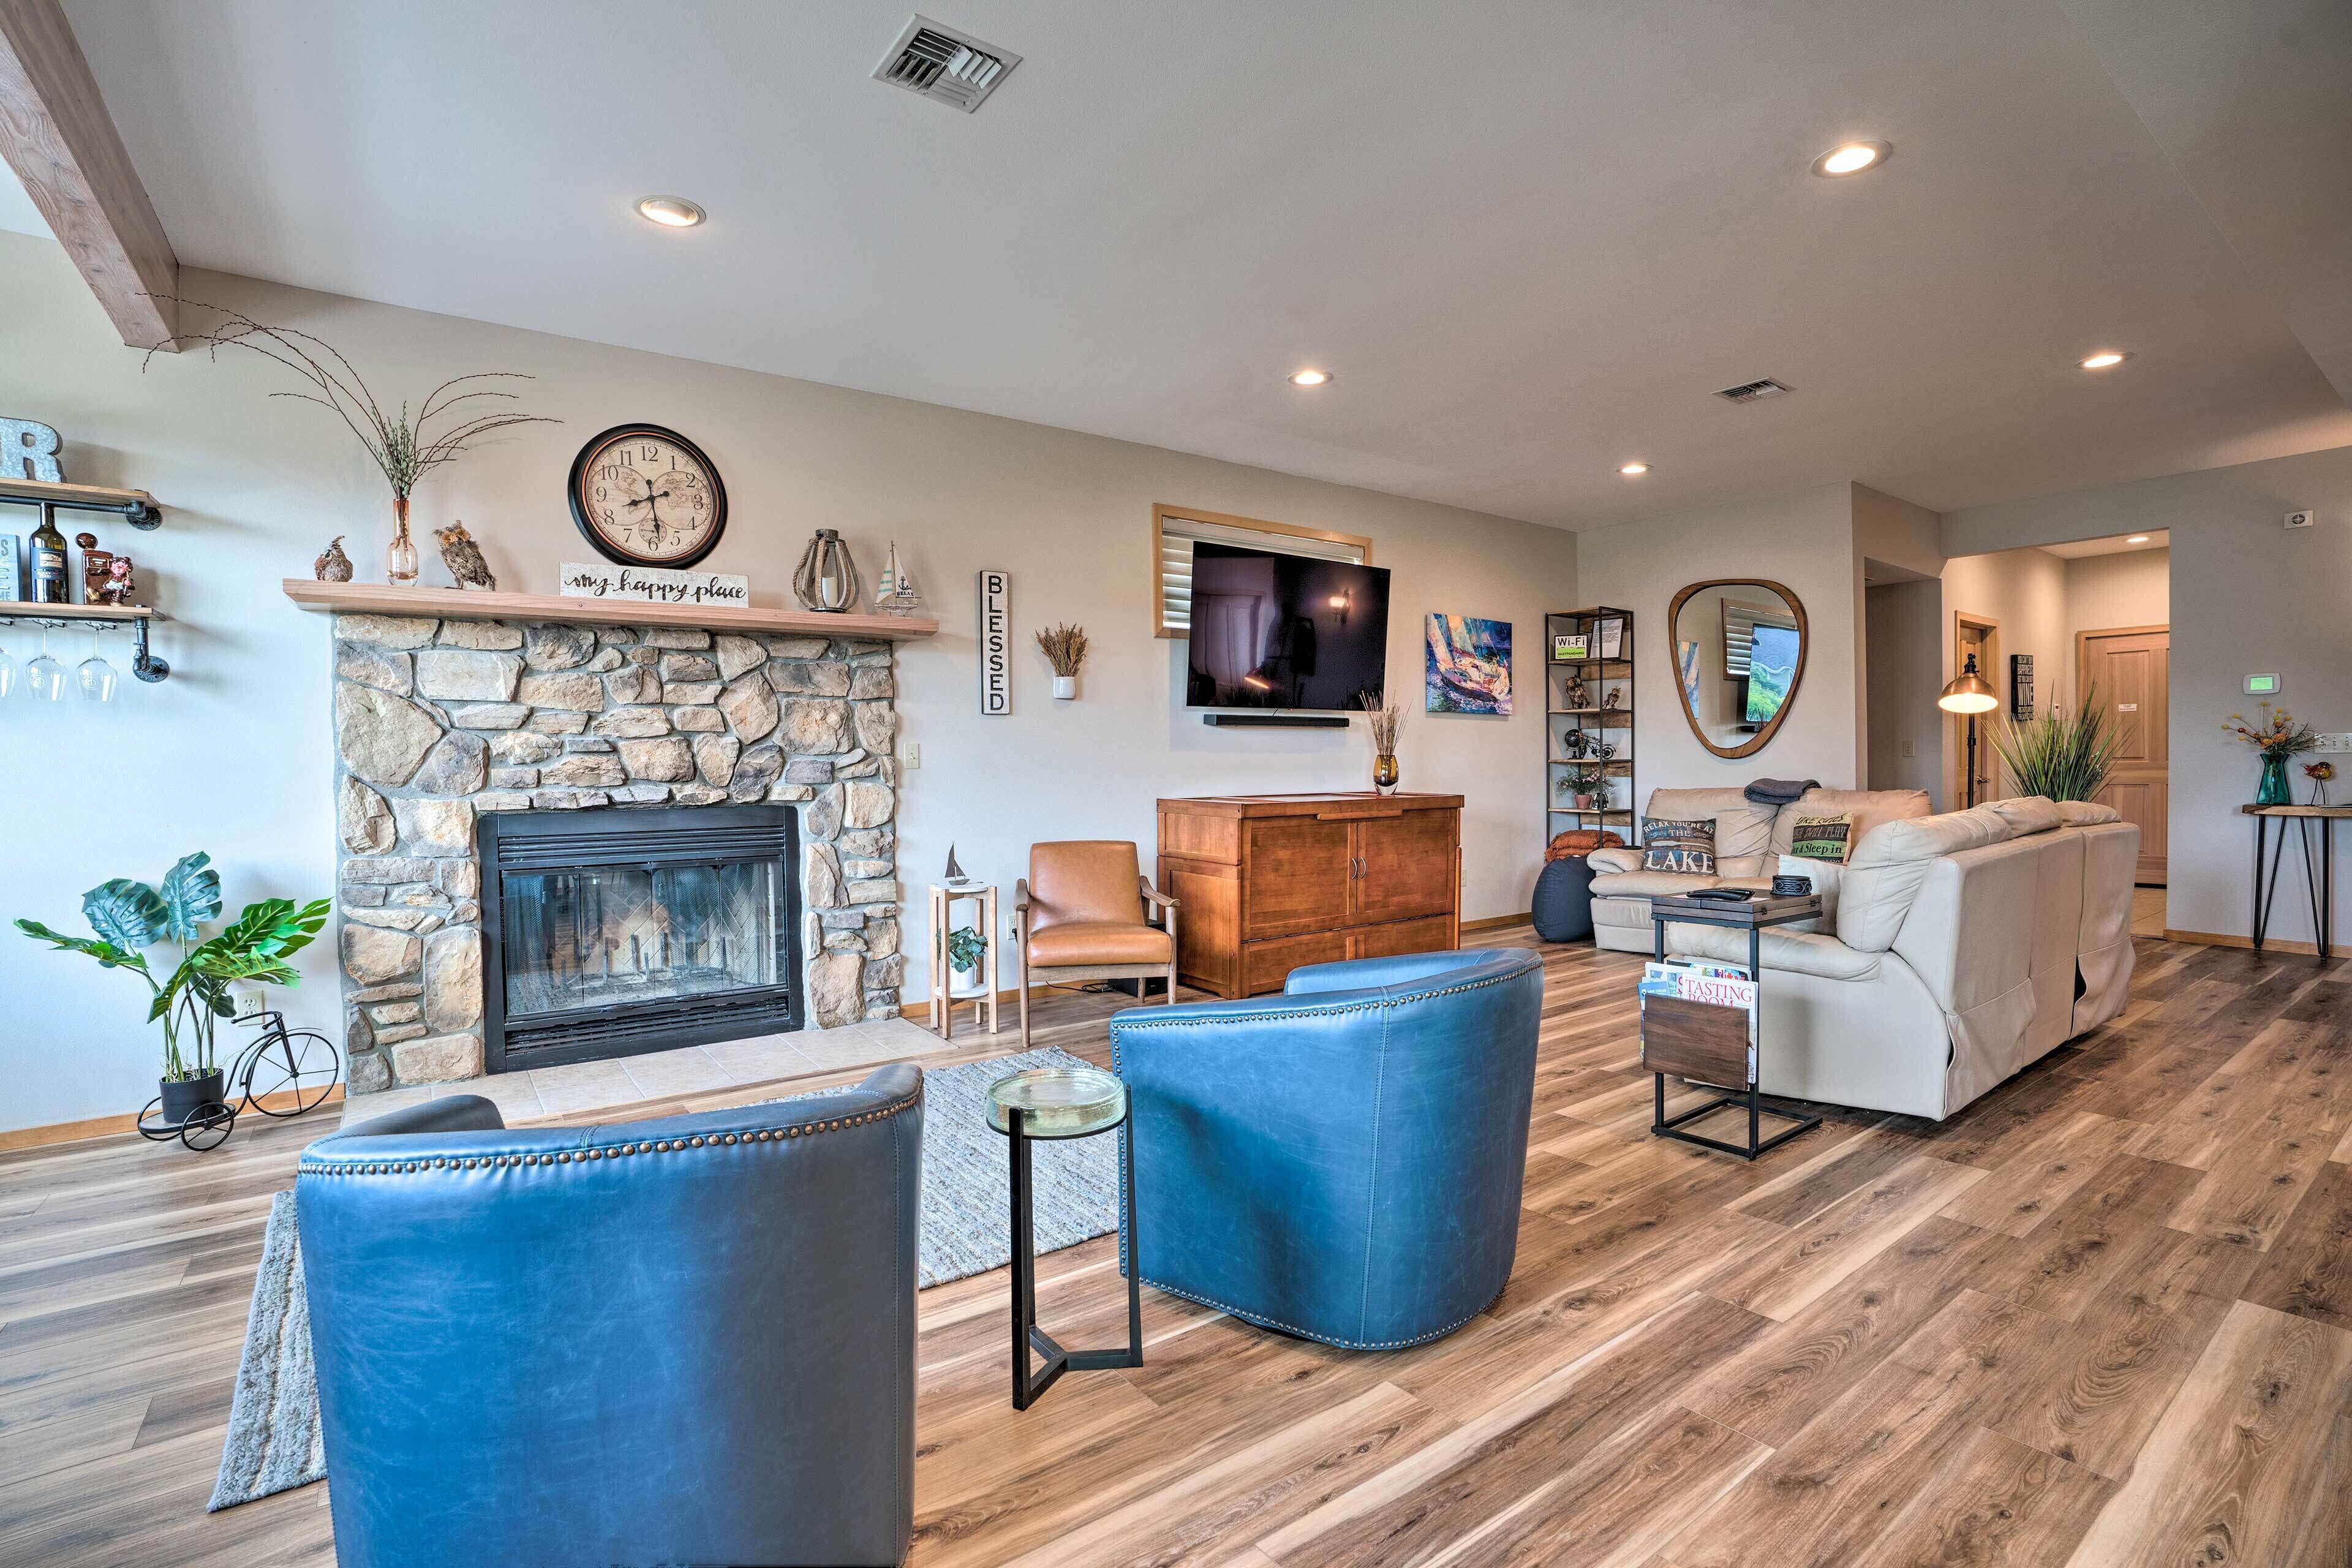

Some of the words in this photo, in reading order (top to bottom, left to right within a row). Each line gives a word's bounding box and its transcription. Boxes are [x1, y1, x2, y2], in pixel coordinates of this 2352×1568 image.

[619, 450, 633, 466] 11
[641, 446, 658, 462] 12
[669, 455, 676, 470] 1
[600, 465, 619, 481] 10
[686, 473, 696, 488] 2
[596, 487, 607, 502] 9
[693, 494, 703, 510] 3
[604, 509, 614, 525] 8
[687, 516, 696, 530] 4
[623, 528, 632, 543] 7
[649, 536, 658, 551] 6
[671, 530, 680, 546] 5
[564, 574, 613, 597] my
[612, 569, 689, 602] happy
[690, 576, 746, 603] place
[988, 575, 1004, 710] BLESSED
[1558, 637, 1585, 646] Wi-Fi
[2018, 683, 2033, 706] WINE
[1643, 821, 1669, 833] RELAX
[1704, 826, 1714, 834] AT
[1825, 826, 1847, 838] PLAY
[1804, 843, 1828, 855] Sleep
[1831, 844, 1842, 854] in
[1646, 850, 1714, 873] LAKE
[1686, 979, 1752, 1002] TASTING
